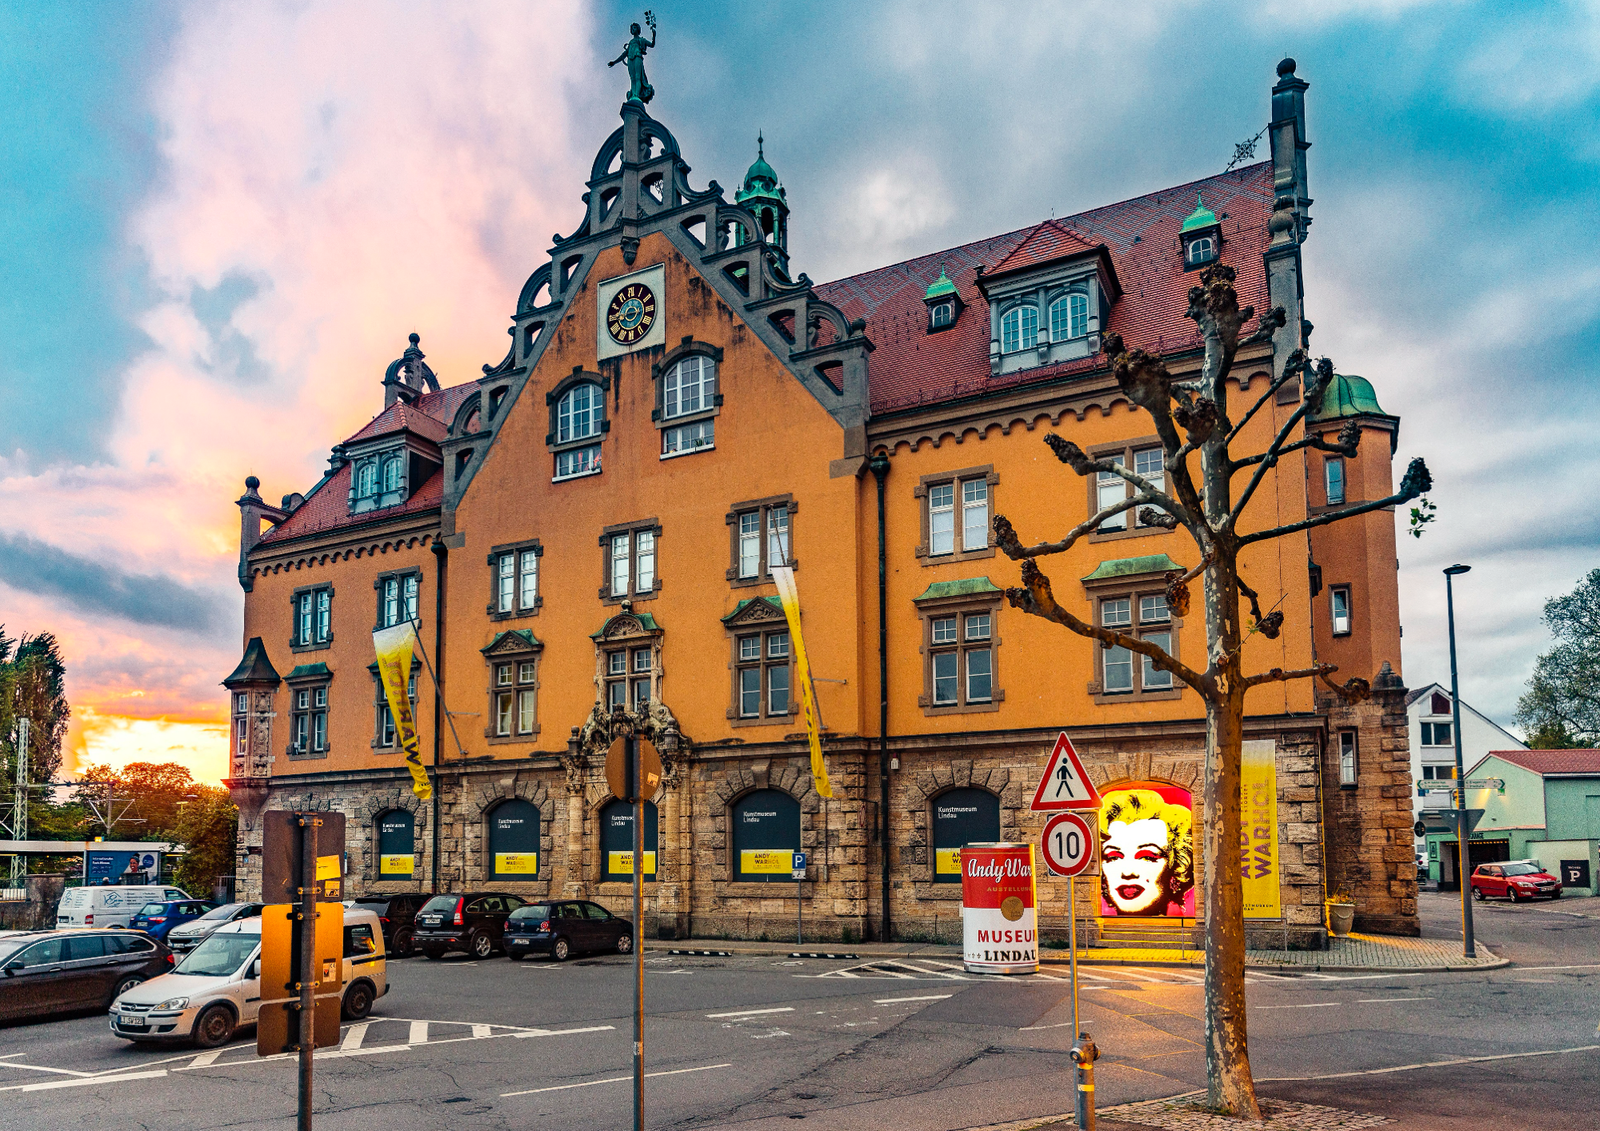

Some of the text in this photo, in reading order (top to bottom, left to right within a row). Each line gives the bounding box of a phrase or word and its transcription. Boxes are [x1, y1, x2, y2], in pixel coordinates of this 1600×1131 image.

[1252, 776, 1272, 880] WARHOL
[1055, 831, 1080, 860] 10
[794, 855, 804, 867] P
[967, 858, 1005, 883] Andy
[1569, 870, 1581, 882] P
[984, 950, 1036, 961] LINDAU
